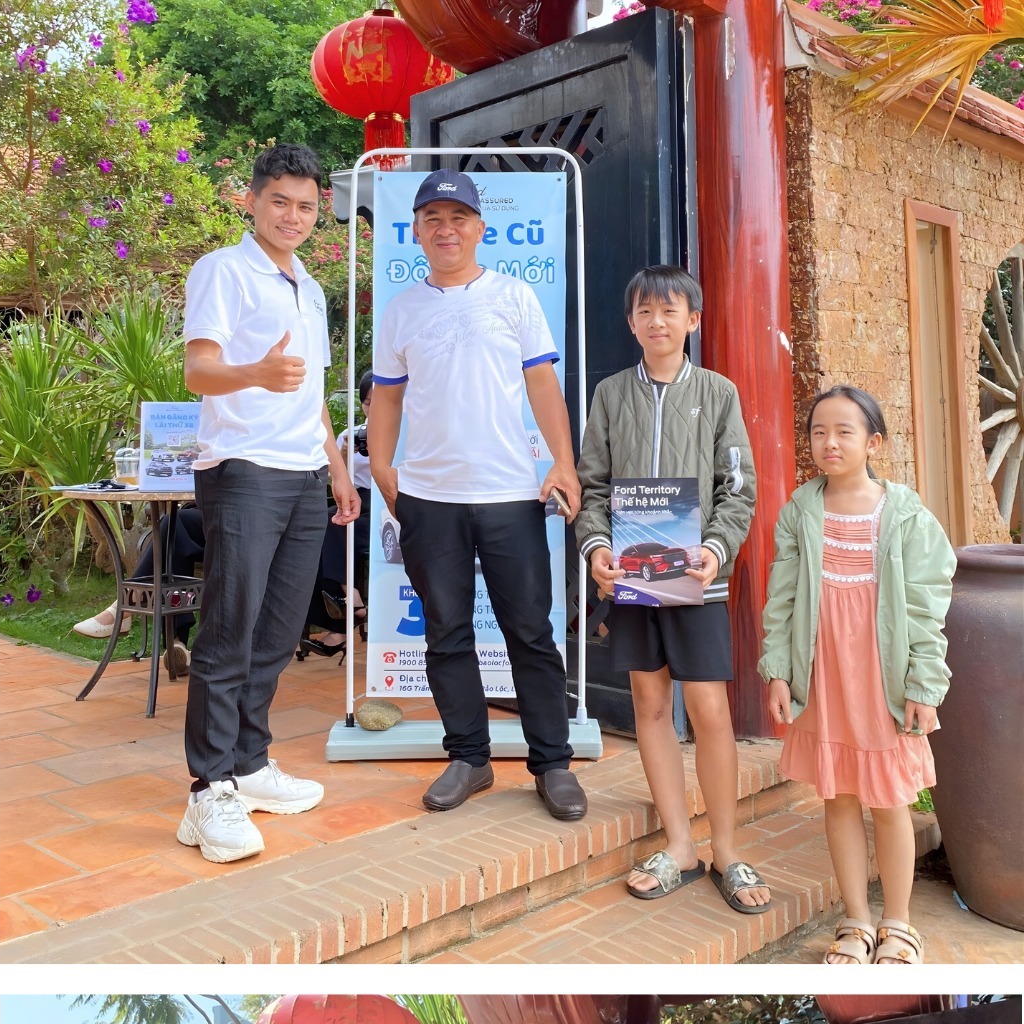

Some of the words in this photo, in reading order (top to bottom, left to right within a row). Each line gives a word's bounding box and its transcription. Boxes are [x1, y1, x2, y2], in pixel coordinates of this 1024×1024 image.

[437, 183, 457, 192] Ford
[506, 219, 545, 245] Cũ
[614, 486, 636, 495] Ford
[639, 486, 681, 495] Territory
[614, 497, 634, 506] Thế
[636, 498, 648, 508] hệ
[651, 497, 669, 506] Mới
[617, 591, 638, 600] Ford
[399, 650, 426, 658] Hotlin
[479, 650, 509, 658] Websi
[399, 675, 413, 684] Địa
